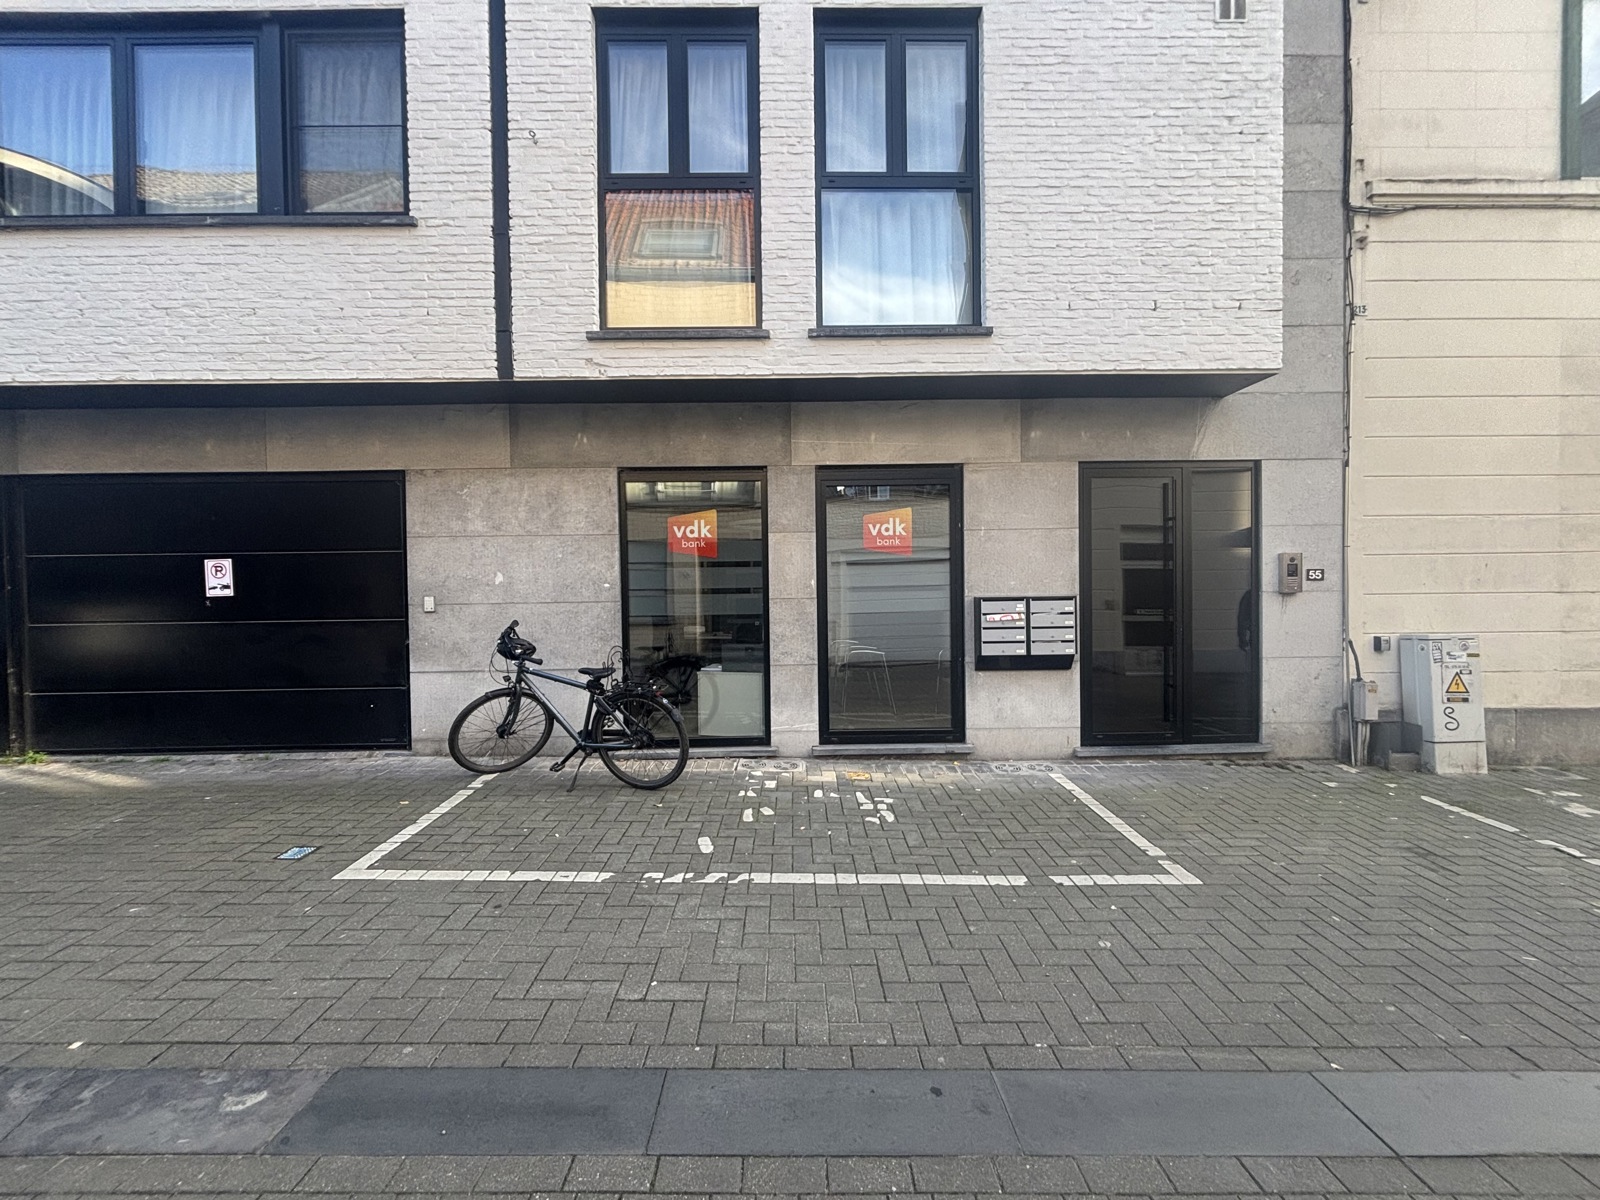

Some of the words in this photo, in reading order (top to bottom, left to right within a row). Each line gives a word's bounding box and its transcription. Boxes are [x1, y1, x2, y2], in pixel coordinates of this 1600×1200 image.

[673, 519, 712, 538] vdk
[868, 517, 907, 536] vdk
[681, 539, 706, 548] bank
[876, 536, 901, 546] bank
[1308, 570, 1322, 579] 55
